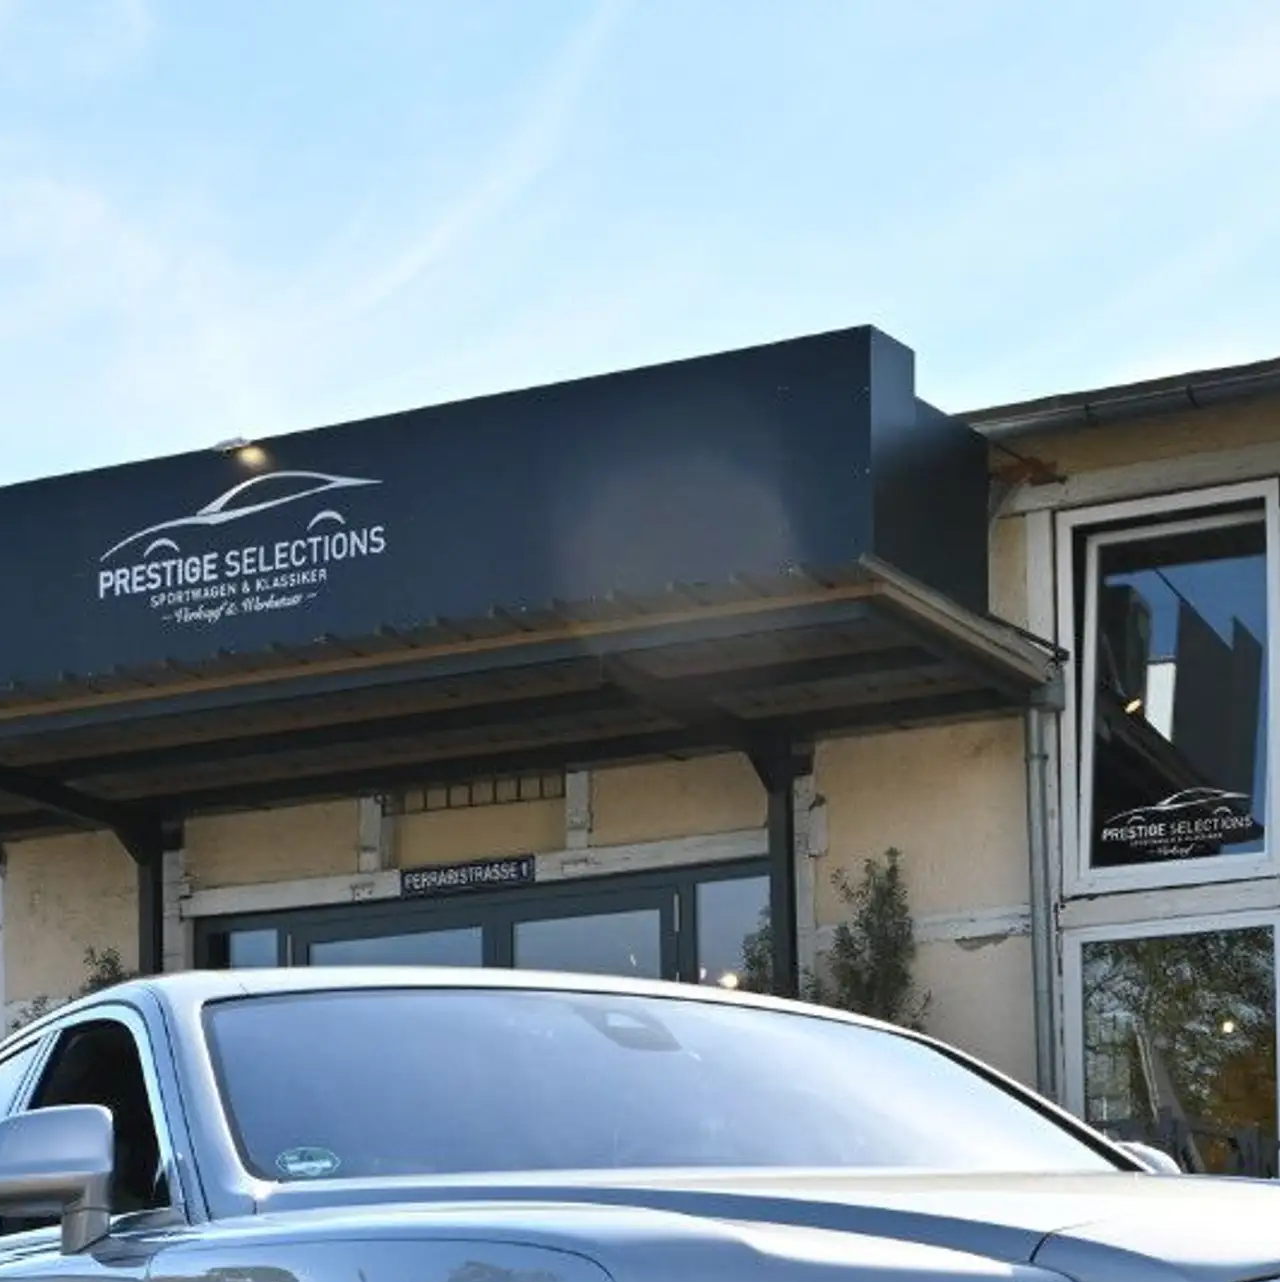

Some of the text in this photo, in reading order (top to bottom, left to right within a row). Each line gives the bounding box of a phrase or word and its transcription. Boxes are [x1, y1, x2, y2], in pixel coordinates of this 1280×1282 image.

[98, 525, 387, 598] PRESTIGE SELECTIONS
[149, 581, 237, 608] SPORTWAGEN
[255, 567, 328, 592] KLASSIKER
